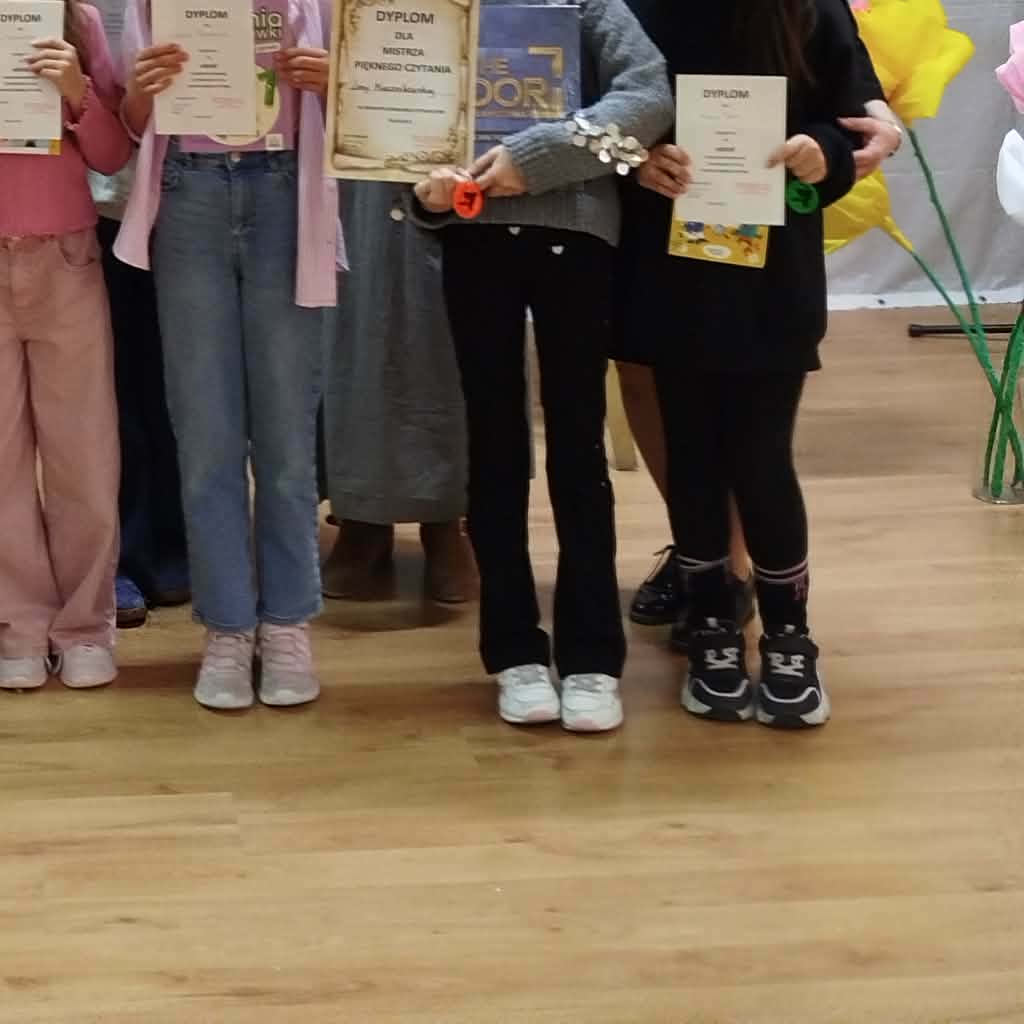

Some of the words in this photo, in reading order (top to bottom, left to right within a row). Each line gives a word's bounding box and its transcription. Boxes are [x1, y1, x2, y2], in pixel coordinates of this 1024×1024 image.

[0, 13, 42, 23] DYPLOM
[184, 9, 228, 19] DYPLOM
[376, 10, 435, 24] DYPLOM
[394, 31, 414, 41] DLA
[382, 47, 425, 57] MISTRZA
[404, 64, 452, 74] CZYTANIA
[703, 89, 750, 99] DYPLOM
